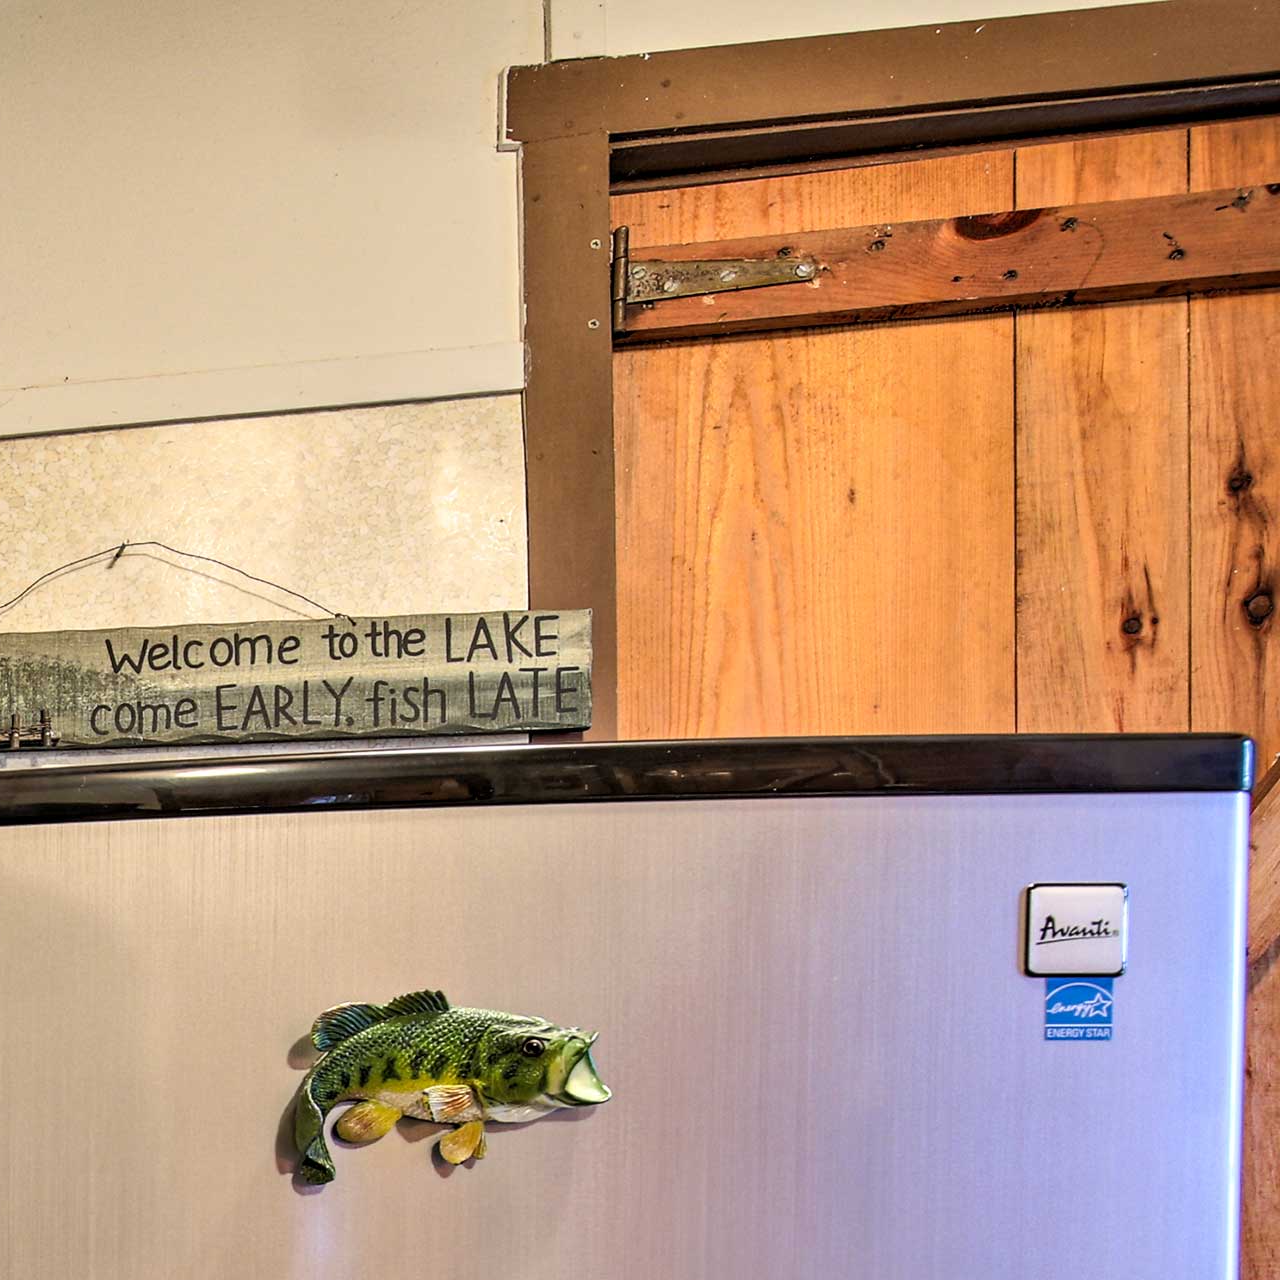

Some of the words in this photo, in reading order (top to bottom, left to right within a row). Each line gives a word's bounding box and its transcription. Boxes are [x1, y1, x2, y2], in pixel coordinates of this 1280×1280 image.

[105, 633, 301, 674] Welcome
[322, 624, 359, 660] to
[365, 621, 426, 659] the
[444, 612, 561, 663] LAKE
[90, 697, 198, 736] come
[367, 676, 447, 728] fish
[468, 666, 581, 719] LATE
[1039, 914, 1112, 941] Avanti
[1046, 1000, 1096, 1018] energy
[1047, 1029, 1084, 1038] ENERGY
[1086, 1028, 1111, 1038] STAR
